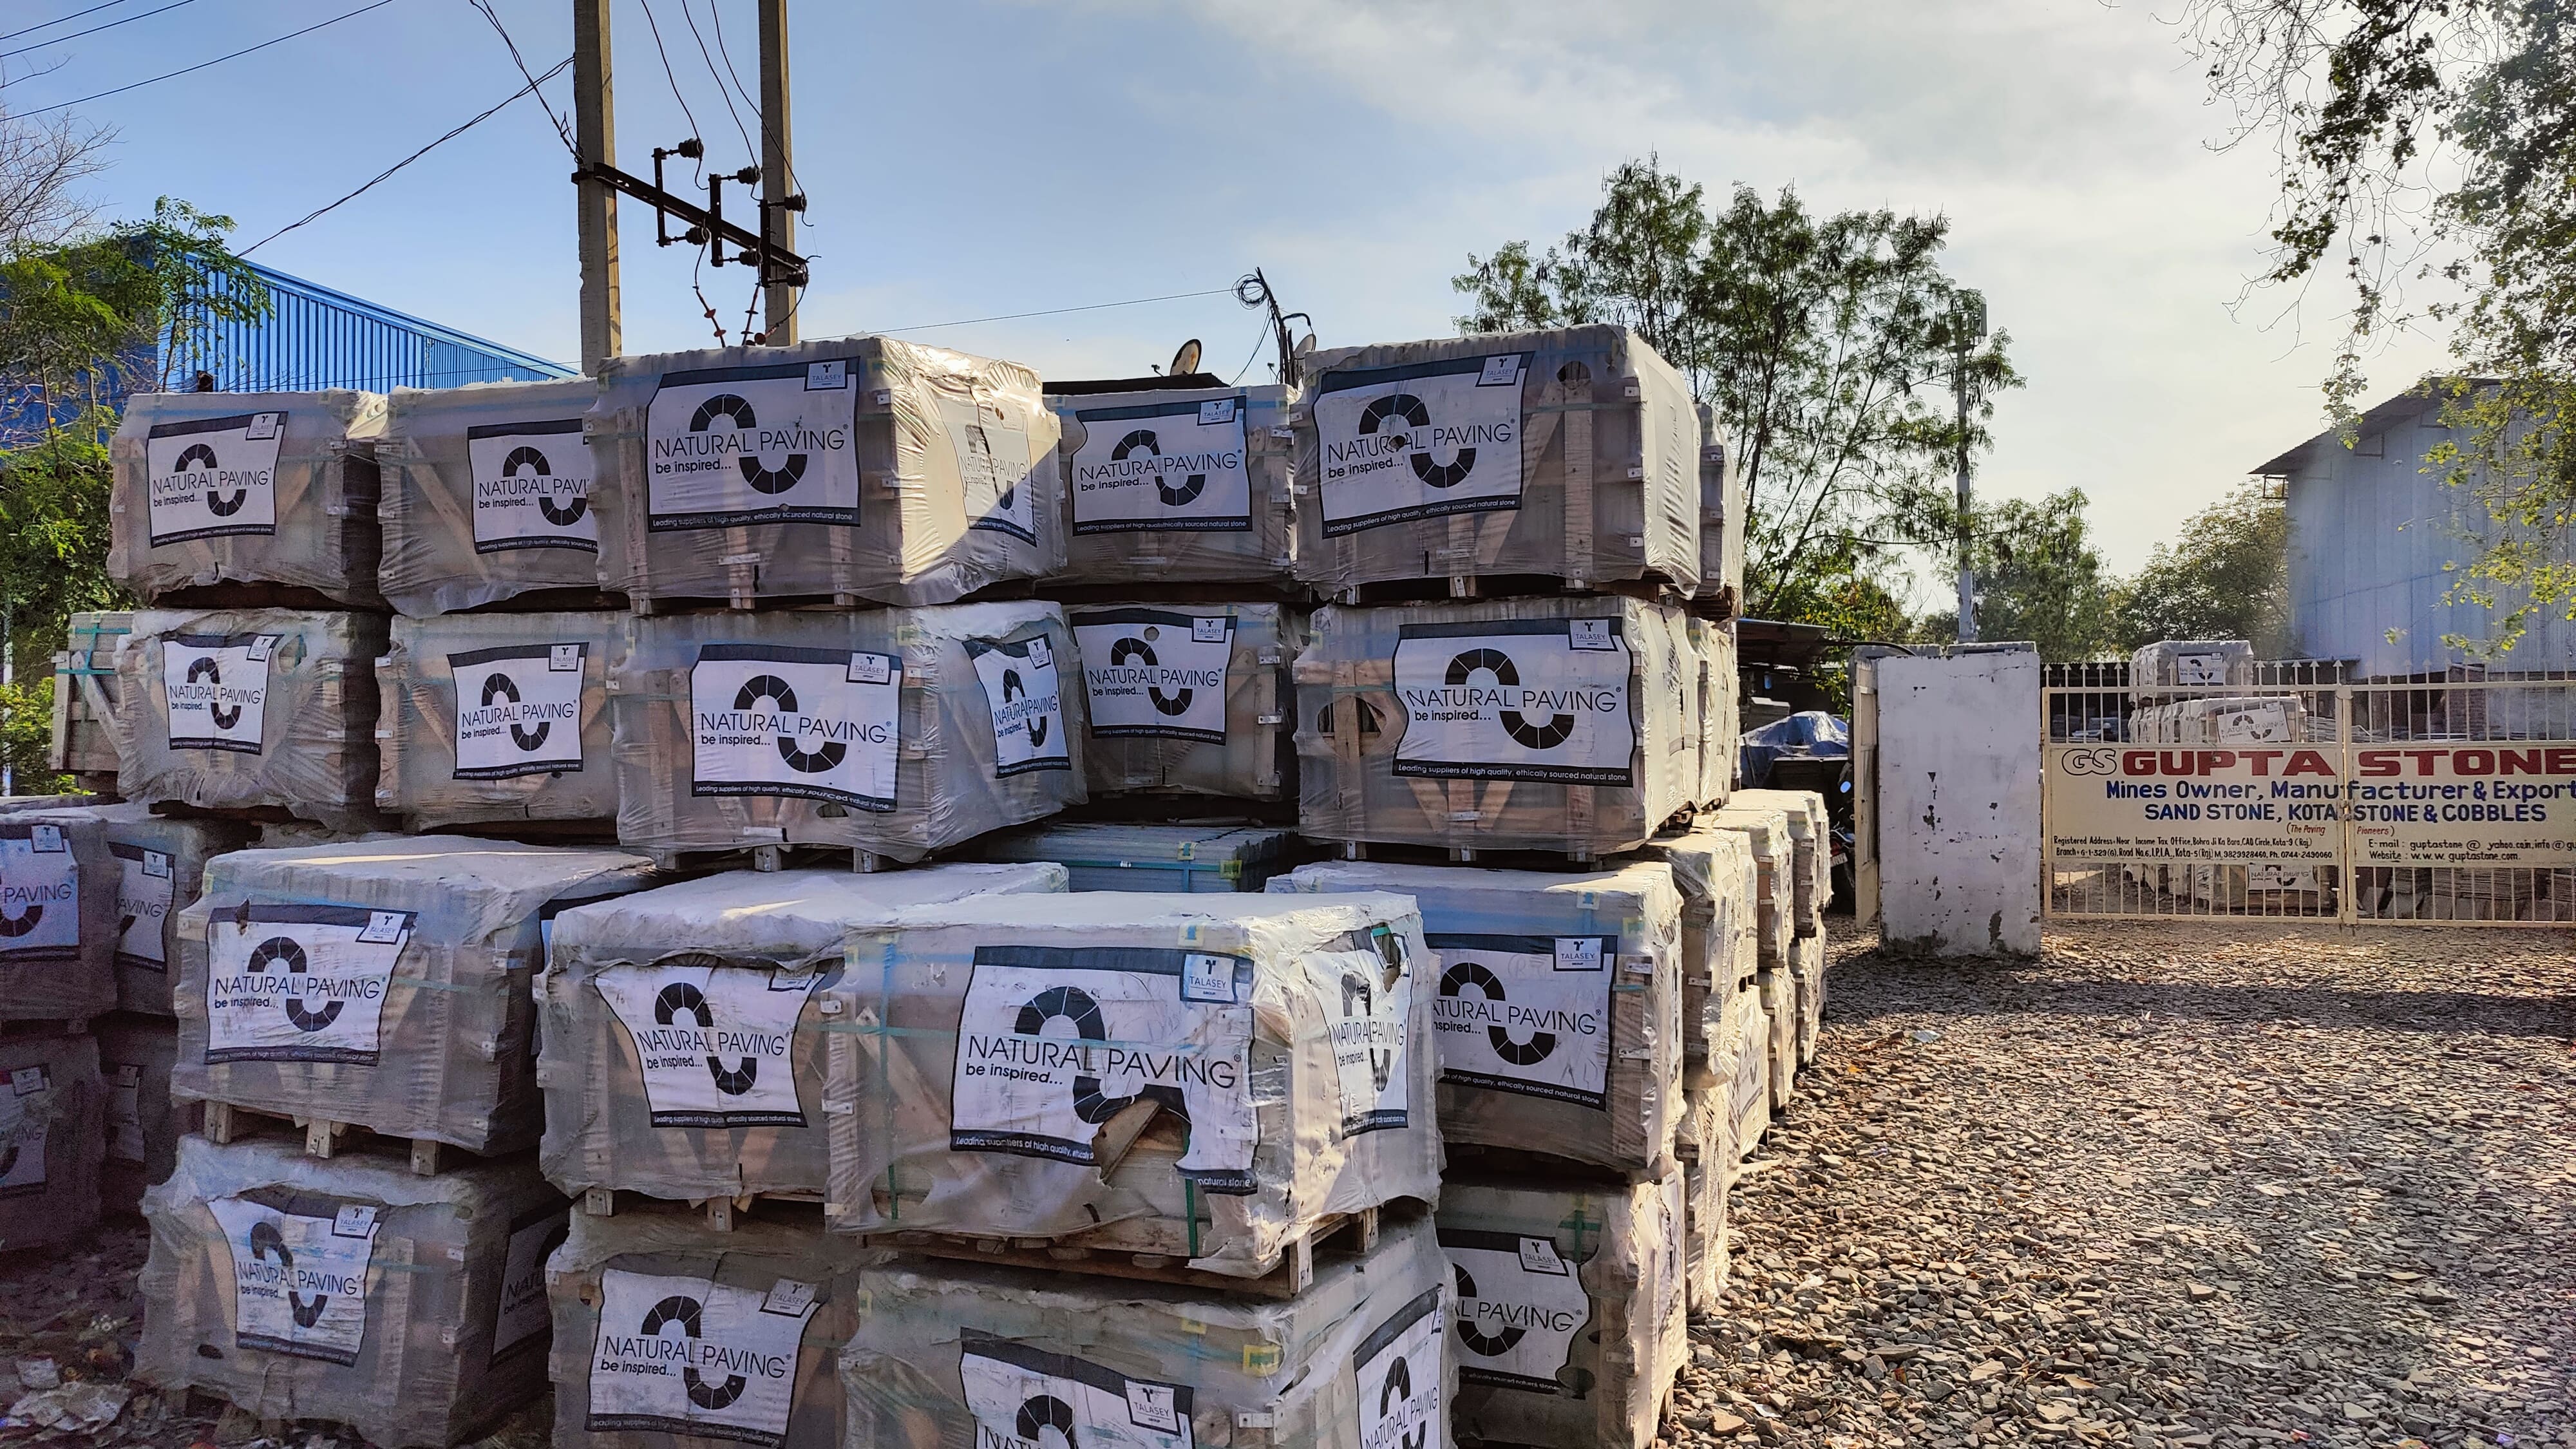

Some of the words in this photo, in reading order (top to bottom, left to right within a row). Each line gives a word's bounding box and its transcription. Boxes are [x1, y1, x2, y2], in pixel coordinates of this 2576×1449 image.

[656, 433, 753, 459] NATURAL
[761, 430, 844, 451] PAVING
[1329, 431, 1426, 462] NATURAL
[1434, 424, 1511, 446] PAVING
[656, 463, 670, 473] be
[960, 456, 994, 473] NATURA
[994, 459, 1027, 480] PAVING
[1165, 453, 1237, 473] PAVING
[1329, 467, 1345, 478] be
[153, 472, 216, 495] NATURAL
[220, 471, 268, 486] PAVING
[480, 479, 549, 497] NATURAL
[554, 478, 589, 493] PAVI
[154, 498, 162, 507] be
[855, 665, 885, 674] TALASEY
[1089, 668, 1156, 684] NATURAL
[1161, 670, 1218, 687] PAVING
[170, 686, 216, 699] NATURAL
[221, 688, 260, 704] PAVING
[1406, 689, 1515, 707] NATURAL
[1523, 690, 1616, 712] PAVING
[1028, 696, 1057, 714] PAVING
[462, 706, 518, 727] NATURAL
[523, 703, 573, 719] PAVING
[1415, 710, 1428, 721] be
[701, 714, 790, 733] NATURAL
[799, 717, 887, 743] PAVING
[701, 735, 715, 744] be
[1399, 764, 1426, 773] Leading
[2062, 748, 2117, 775] GS
[2123, 750, 2336, 776] GUPTA
[2358, 748, 2576, 776] STONE
[2107, 781, 2166, 799] Mines
[2176, 781, 2263, 800] Owner,
[2271, 780, 2468, 800] Manufacturer
[2474, 781, 2486, 800] &
[2145, 804, 2200, 820] SAND
[2206, 804, 2282, 822] STONE,
[2289, 804, 2337, 820] KOTA
[2354, 804, 2419, 822] STONE
[2423, 804, 2438, 822] &
[2443, 804, 2546, 822] COBBLES
[2304, 825, 2325, 836] Paving
[2054, 836, 2087, 846] Registered
[2136, 837, 2155, 845] Income
[2157, 837, 2168, 845] Tax
[2410, 840, 2463, 850] guptastone
[2467, 840, 2481, 851] @
[2369, 851, 2401, 860] Website
[5, 884, 71, 904] PAVING
[115, 899, 162, 917] AVING
[215, 976, 299, 996] NATURAL
[307, 978, 379, 998] PAVING
[1189, 976, 1226, 988] TALASEY
[215, 999, 227, 1008] be
[1433, 999, 1501, 1022] TURAL
[1509, 1006, 1596, 1035] PAVING
[1372, 1021, 1404, 1046] PAVING
[638, 1030, 713, 1052] NATURAL
[719, 1032, 784, 1056] PAVING
[647, 1057, 659, 1069] be
[966, 1064, 985, 1076] be
[968, 1036, 1096, 1072] NATURAL
[1108, 1049, 1235, 1088] PAVING
[1497, 1081, 1524, 1090] ethically
[1526, 1085, 1553, 1095] sourced
[1555, 1090, 1580, 1099] natural
[1582, 1095, 1599, 1104] stone
[1524, 1253, 1556, 1264] TALASEY
[299, 1271, 357, 1294] PAVING
[774, 1294, 805, 1305] TALASEY
[1478, 1302, 1574, 1331] PAVING
[601, 1359, 618, 1370] be
[605, 1336, 694, 1363] NATURAL
[703, 1345, 784, 1378] PAVING
[1134, 1402, 1168, 1417] TALASEY
[1366, 1406, 1408, 1449] NATURAL
[1411, 1387, 1437, 1423] PAVING
